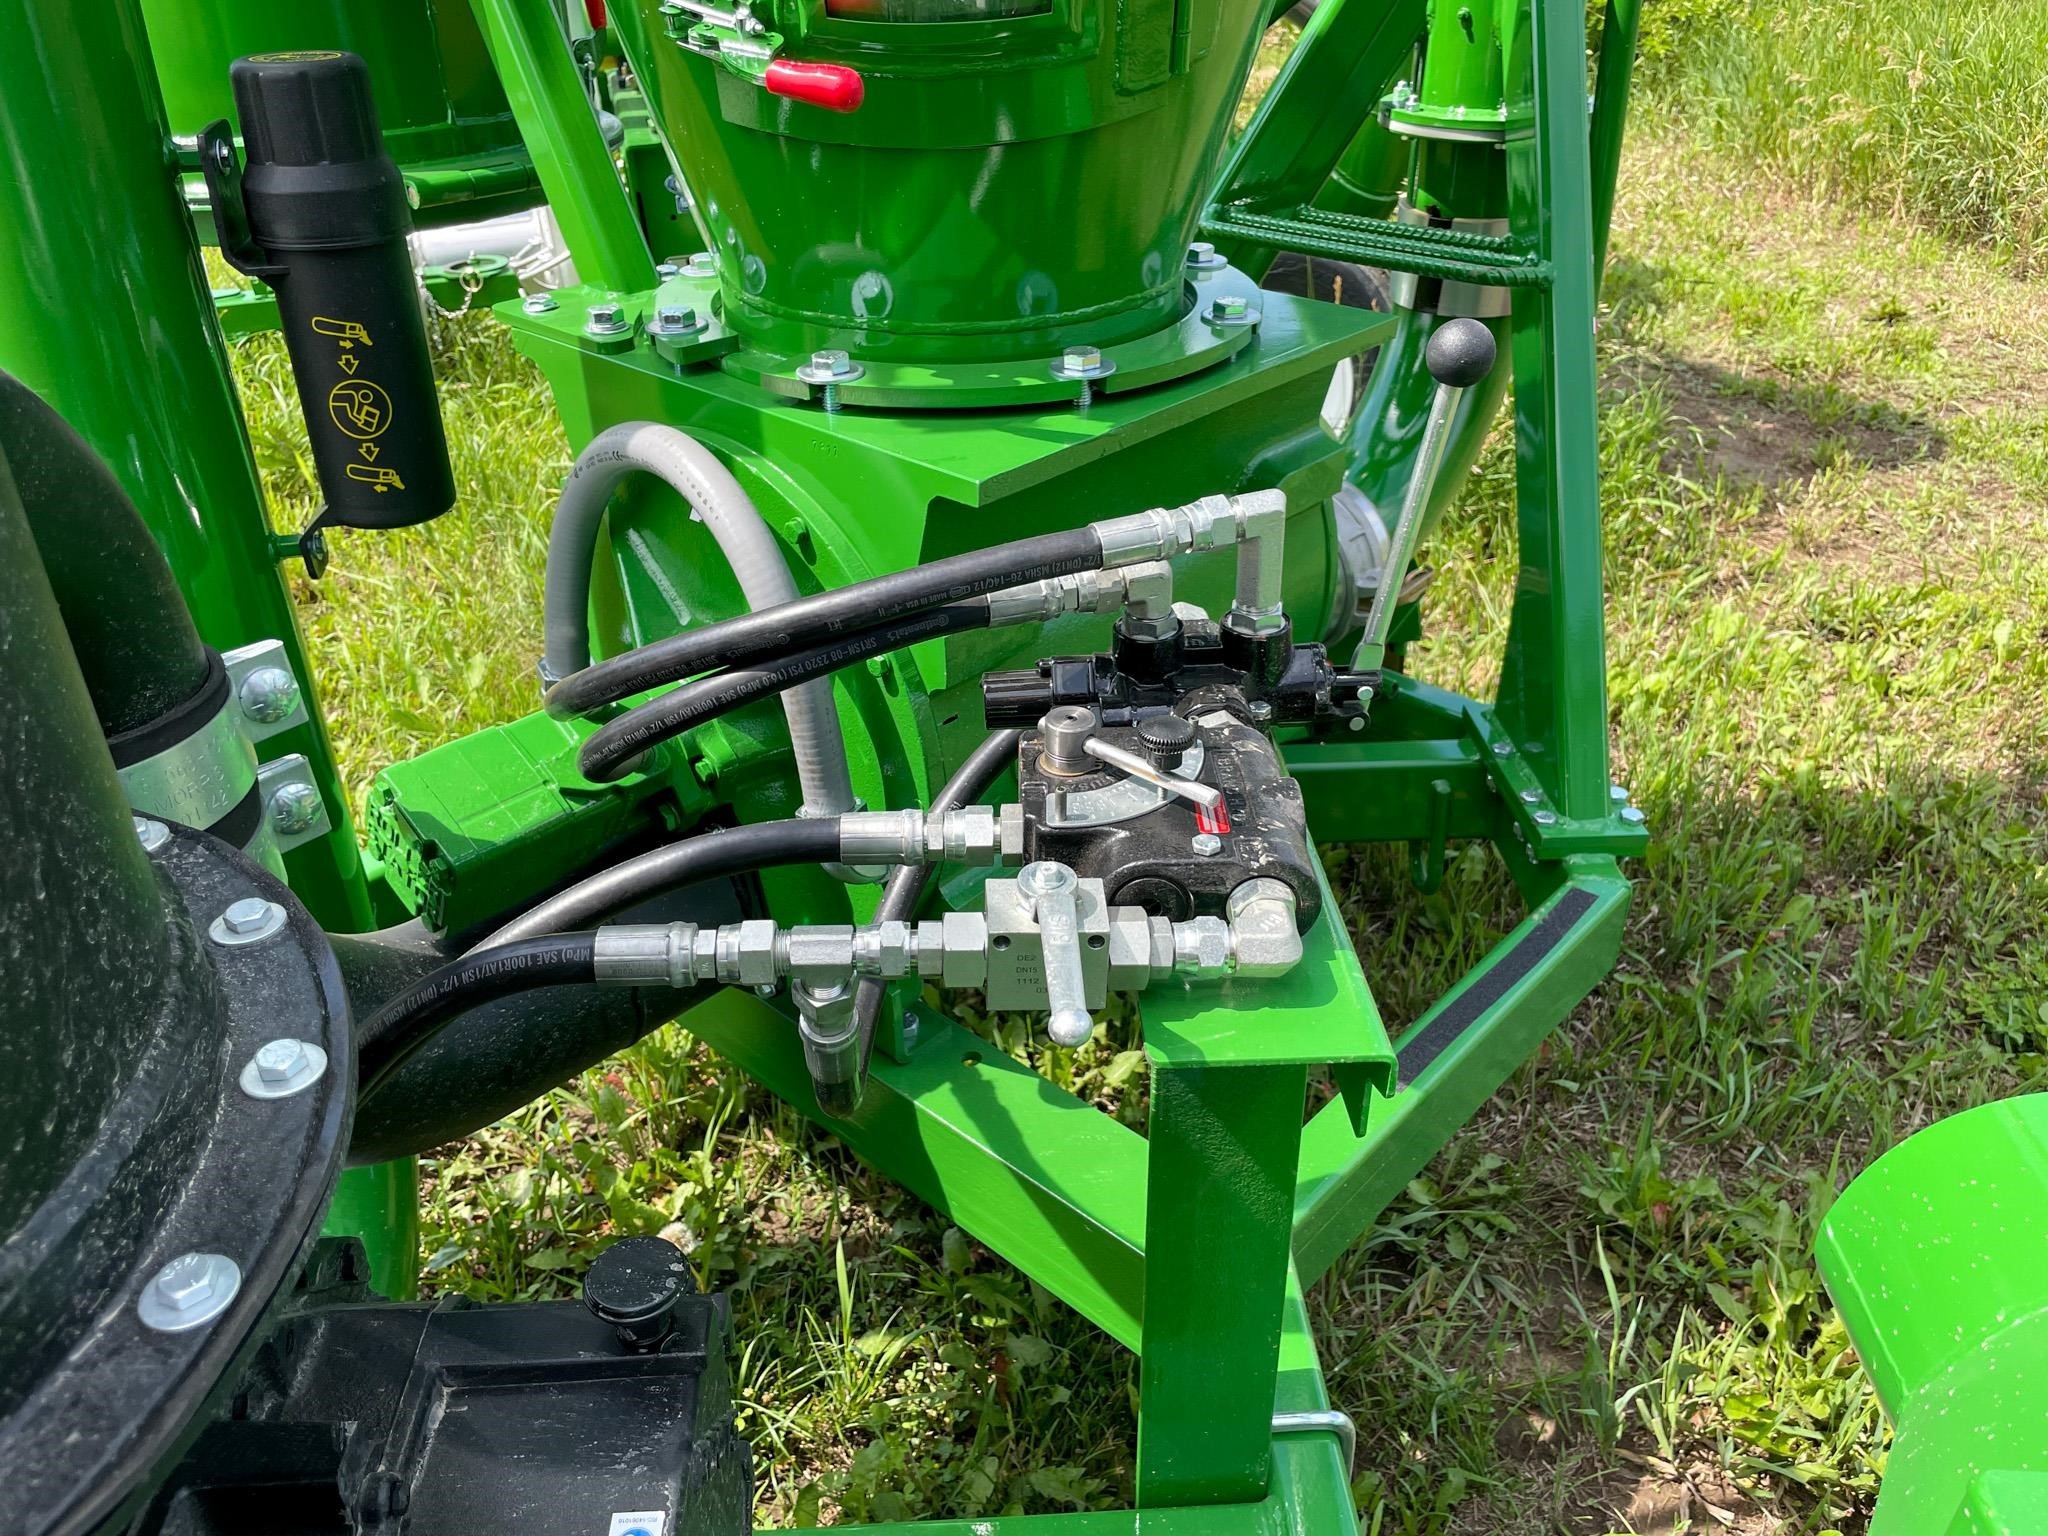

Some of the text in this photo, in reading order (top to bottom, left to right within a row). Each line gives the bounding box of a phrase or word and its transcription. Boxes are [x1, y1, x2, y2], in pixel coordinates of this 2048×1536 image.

[1025, 563, 1050, 578] MSHA
[1052, 557, 1082, 573] (DN12)
[906, 599, 919, 608] USA
[928, 592, 948, 602] MADE
[789, 663, 803, 677] PSI
[805, 655, 829, 671] 2320
[762, 668, 787, 686] (16.0
[737, 677, 760, 697] MPa)
[720, 688, 738, 705] SAE
[663, 696, 719, 728] 100R1AT/1SN
[625, 725, 649, 745] (DN12)
[536, 951, 558, 966] SAE
[562, 947, 590, 963] MPa)
[461, 954, 532, 985] 100R1AT/1SN
[439, 975, 460, 994] 1/2"
[406, 983, 438, 1009] (DN12)
